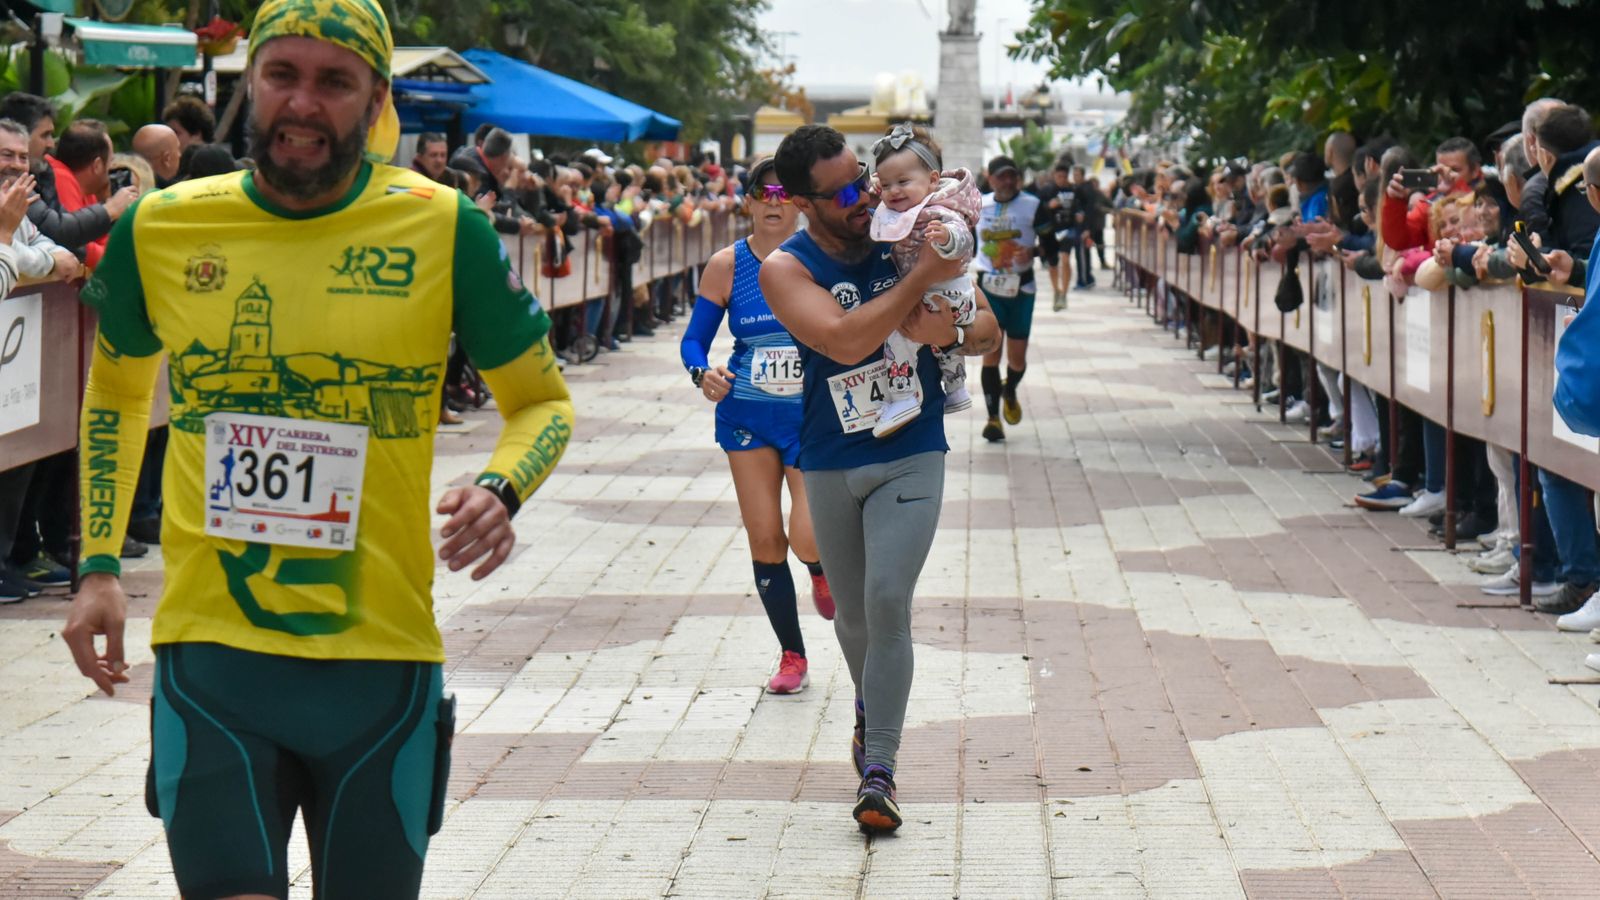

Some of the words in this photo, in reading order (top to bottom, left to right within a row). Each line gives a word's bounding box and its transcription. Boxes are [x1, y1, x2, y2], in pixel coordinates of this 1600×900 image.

[836, 291, 860, 306] IZZA
[740, 315, 757, 326] Club
[757, 312, 777, 323] Atlet
[766, 350, 784, 360] XIV
[769, 360, 804, 379] 115
[841, 371, 867, 390] XIV
[227, 422, 276, 449] XIV
[276, 428, 331, 443] CARRERA
[276, 440, 299, 452] DEL
[300, 442, 359, 458] ESTRECHO
[511, 414, 571, 493] UNNERS
[88, 408, 121, 540] RUNNERS
[236, 449, 315, 504] 361
